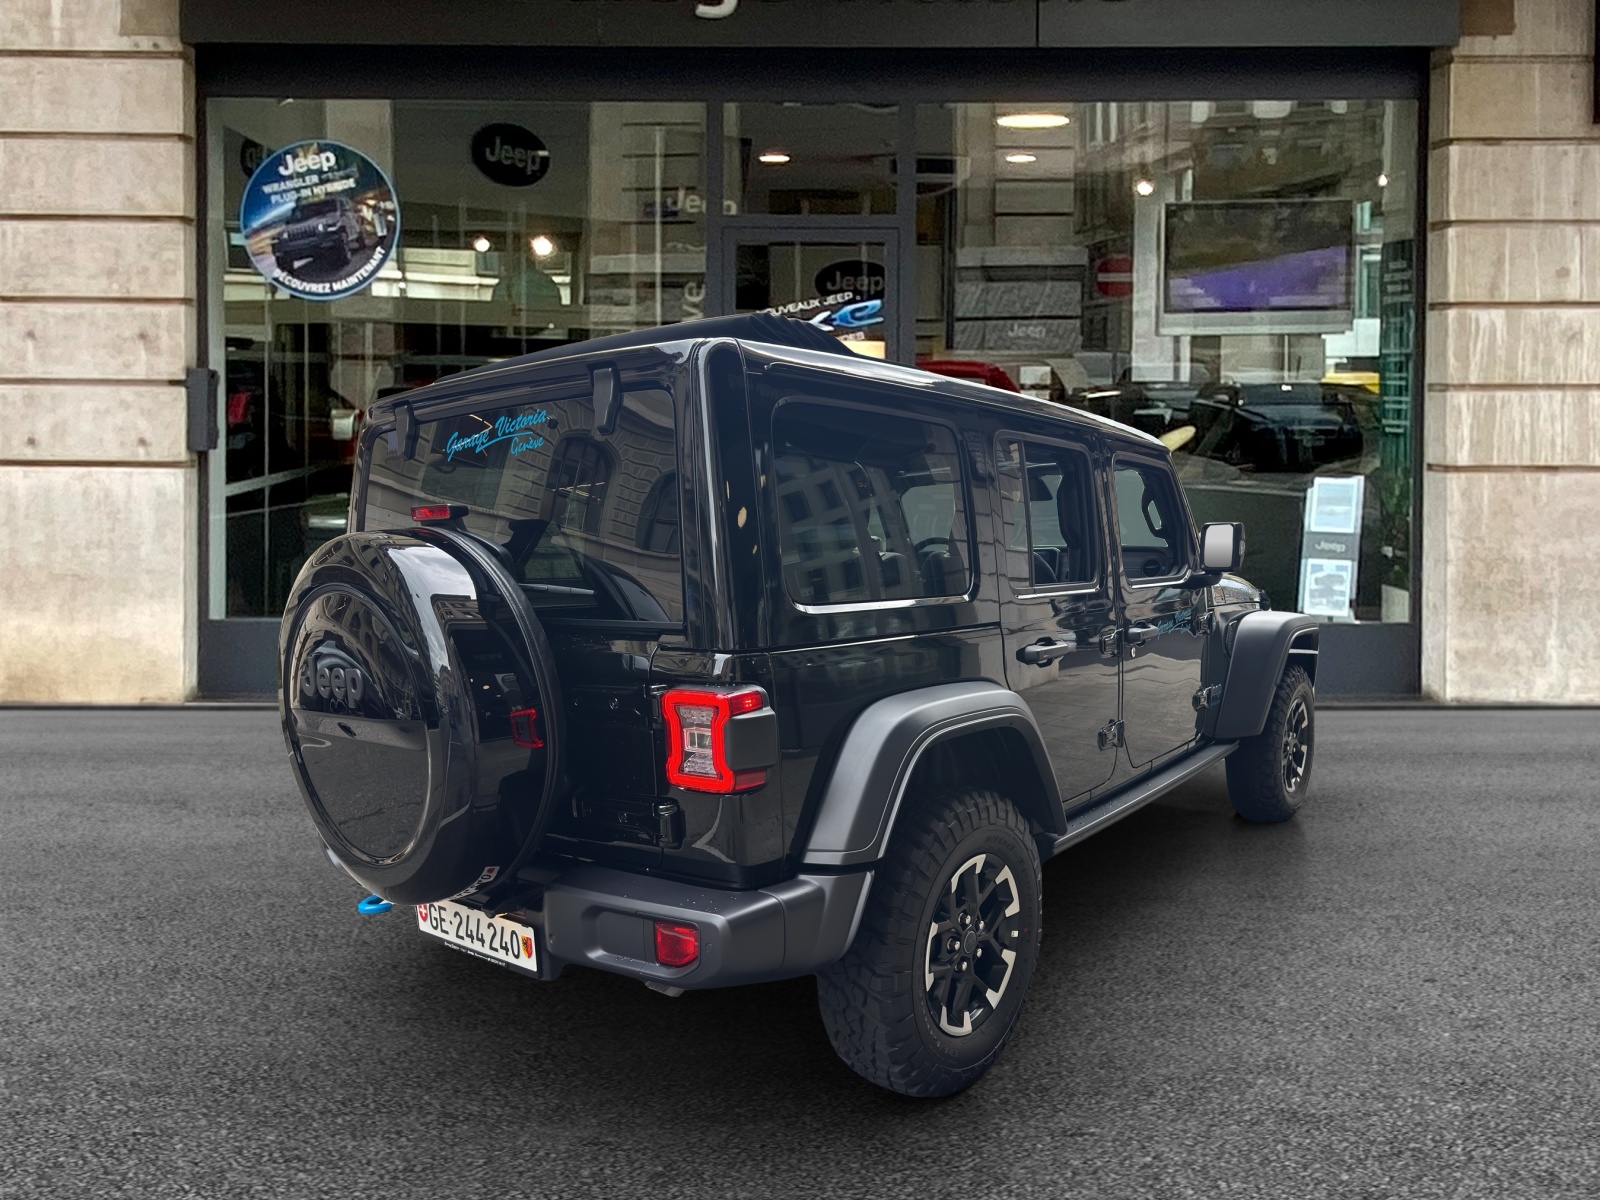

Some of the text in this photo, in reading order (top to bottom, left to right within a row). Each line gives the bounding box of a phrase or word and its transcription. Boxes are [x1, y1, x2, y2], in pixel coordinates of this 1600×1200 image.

[278, 150, 337, 177] Jeep
[485, 136, 541, 176] Jeep
[262, 175, 320, 195] WRANGLER
[270, 189, 313, 204] PLUG-IN
[332, 246, 386, 292] MAINTENANT
[826, 270, 884, 295] Jeep
[823, 291, 853, 306] JEEP
[495, 408, 547, 437] Victoria
[510, 436, 544, 456] Genève
[1314, 540, 1346, 553] Jeep
[300, 656, 364, 709] Jeep
